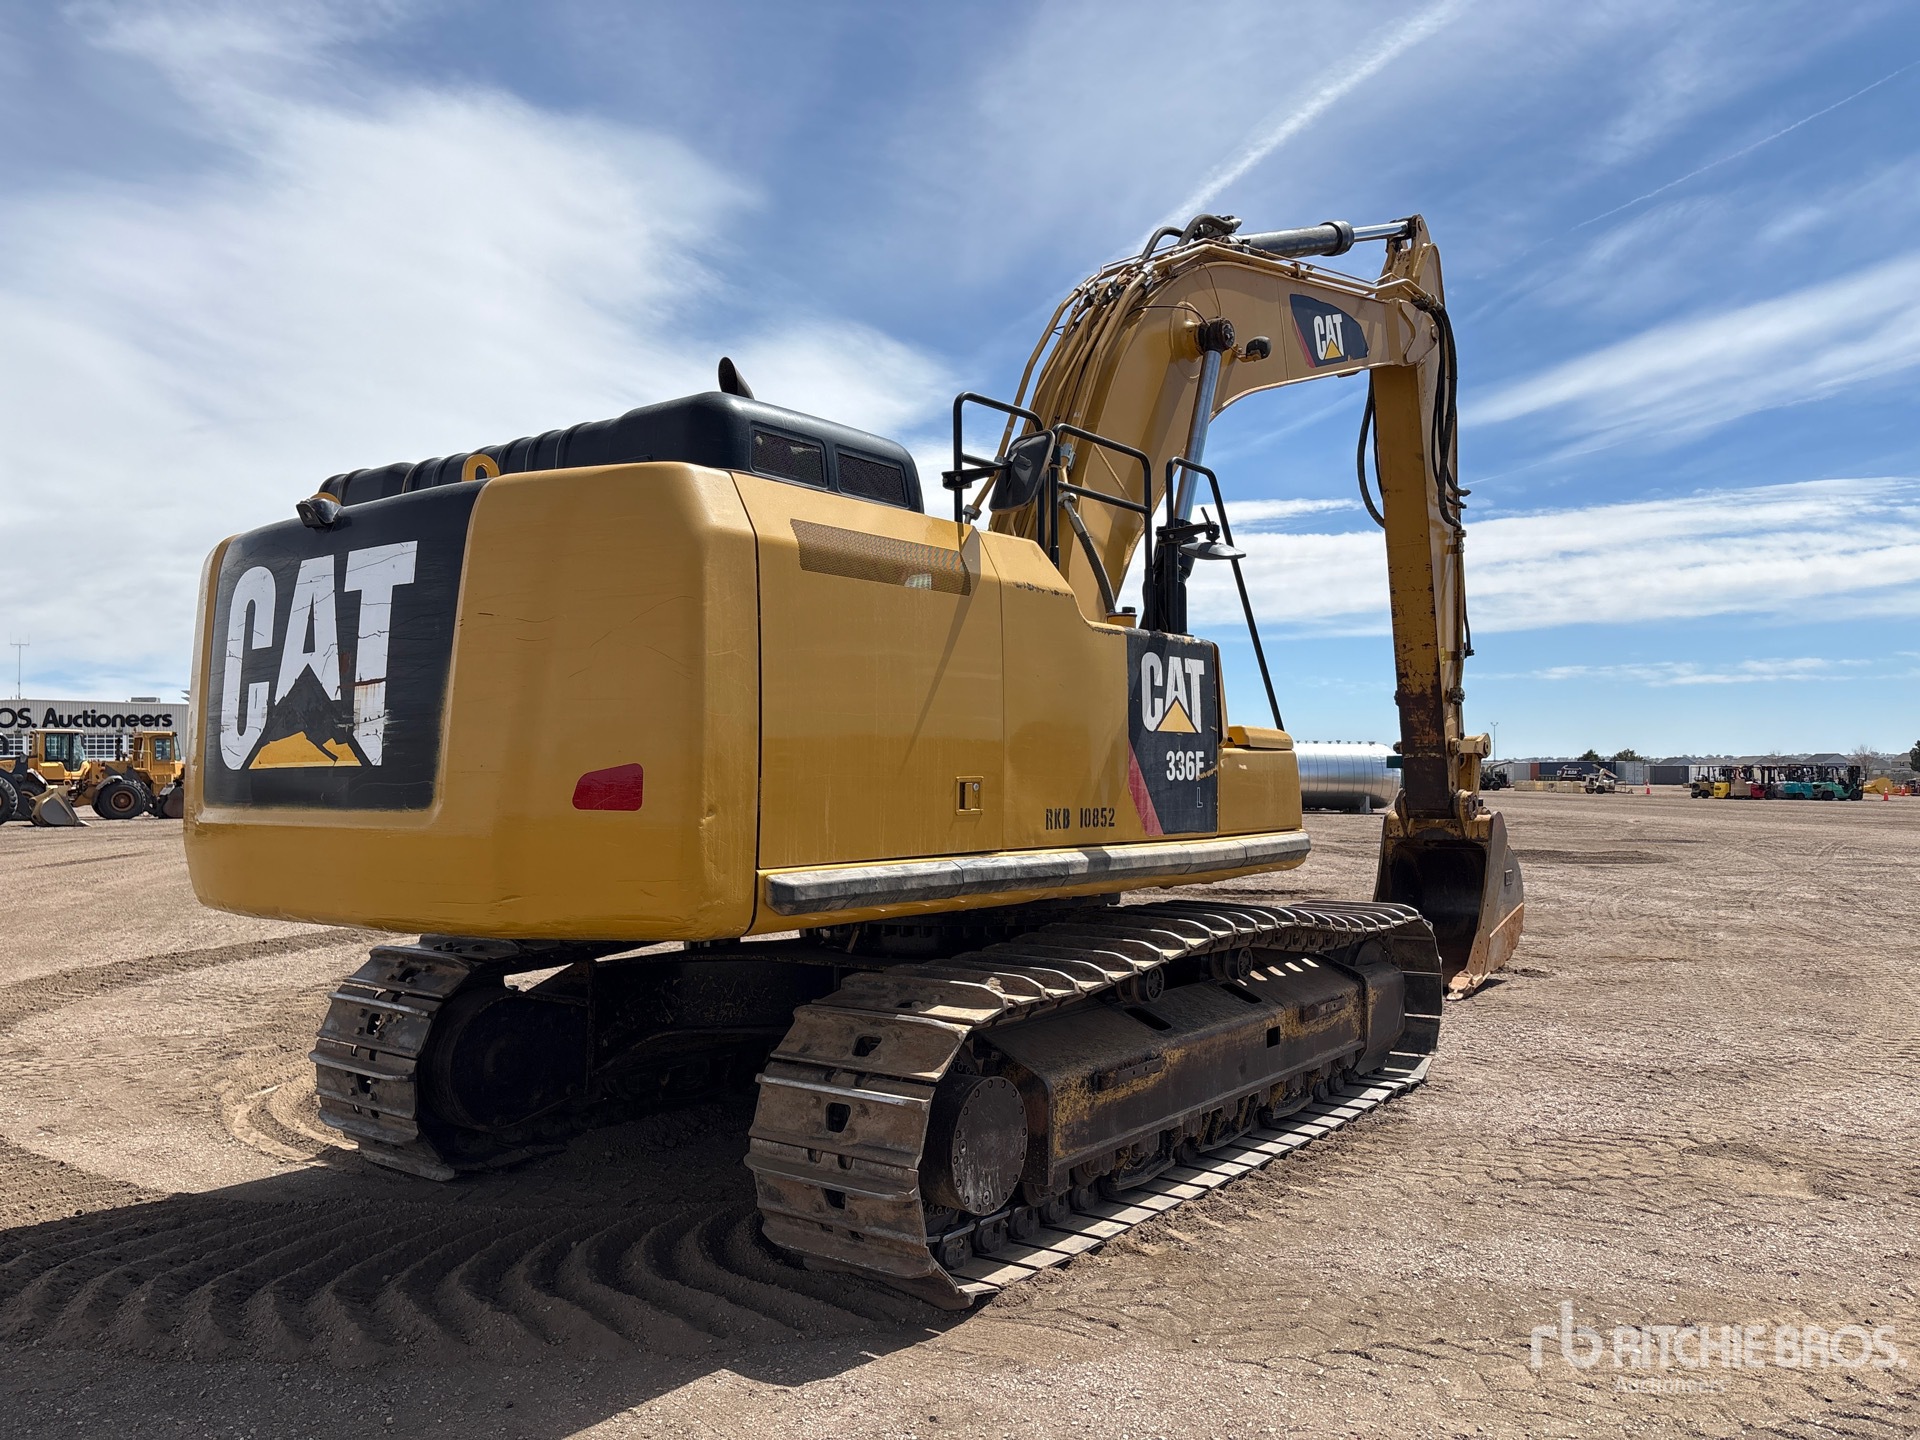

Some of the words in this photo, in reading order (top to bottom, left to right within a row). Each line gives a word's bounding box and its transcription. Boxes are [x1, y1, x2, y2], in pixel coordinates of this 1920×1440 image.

[1313, 313, 1344, 361] CAT
[220, 540, 418, 770] CAT
[1140, 651, 1205, 734] CAT
[42, 707, 173, 728] Auctioneers
[1045, 808, 1071, 830] RKB
[1079, 807, 1116, 828] 10852
